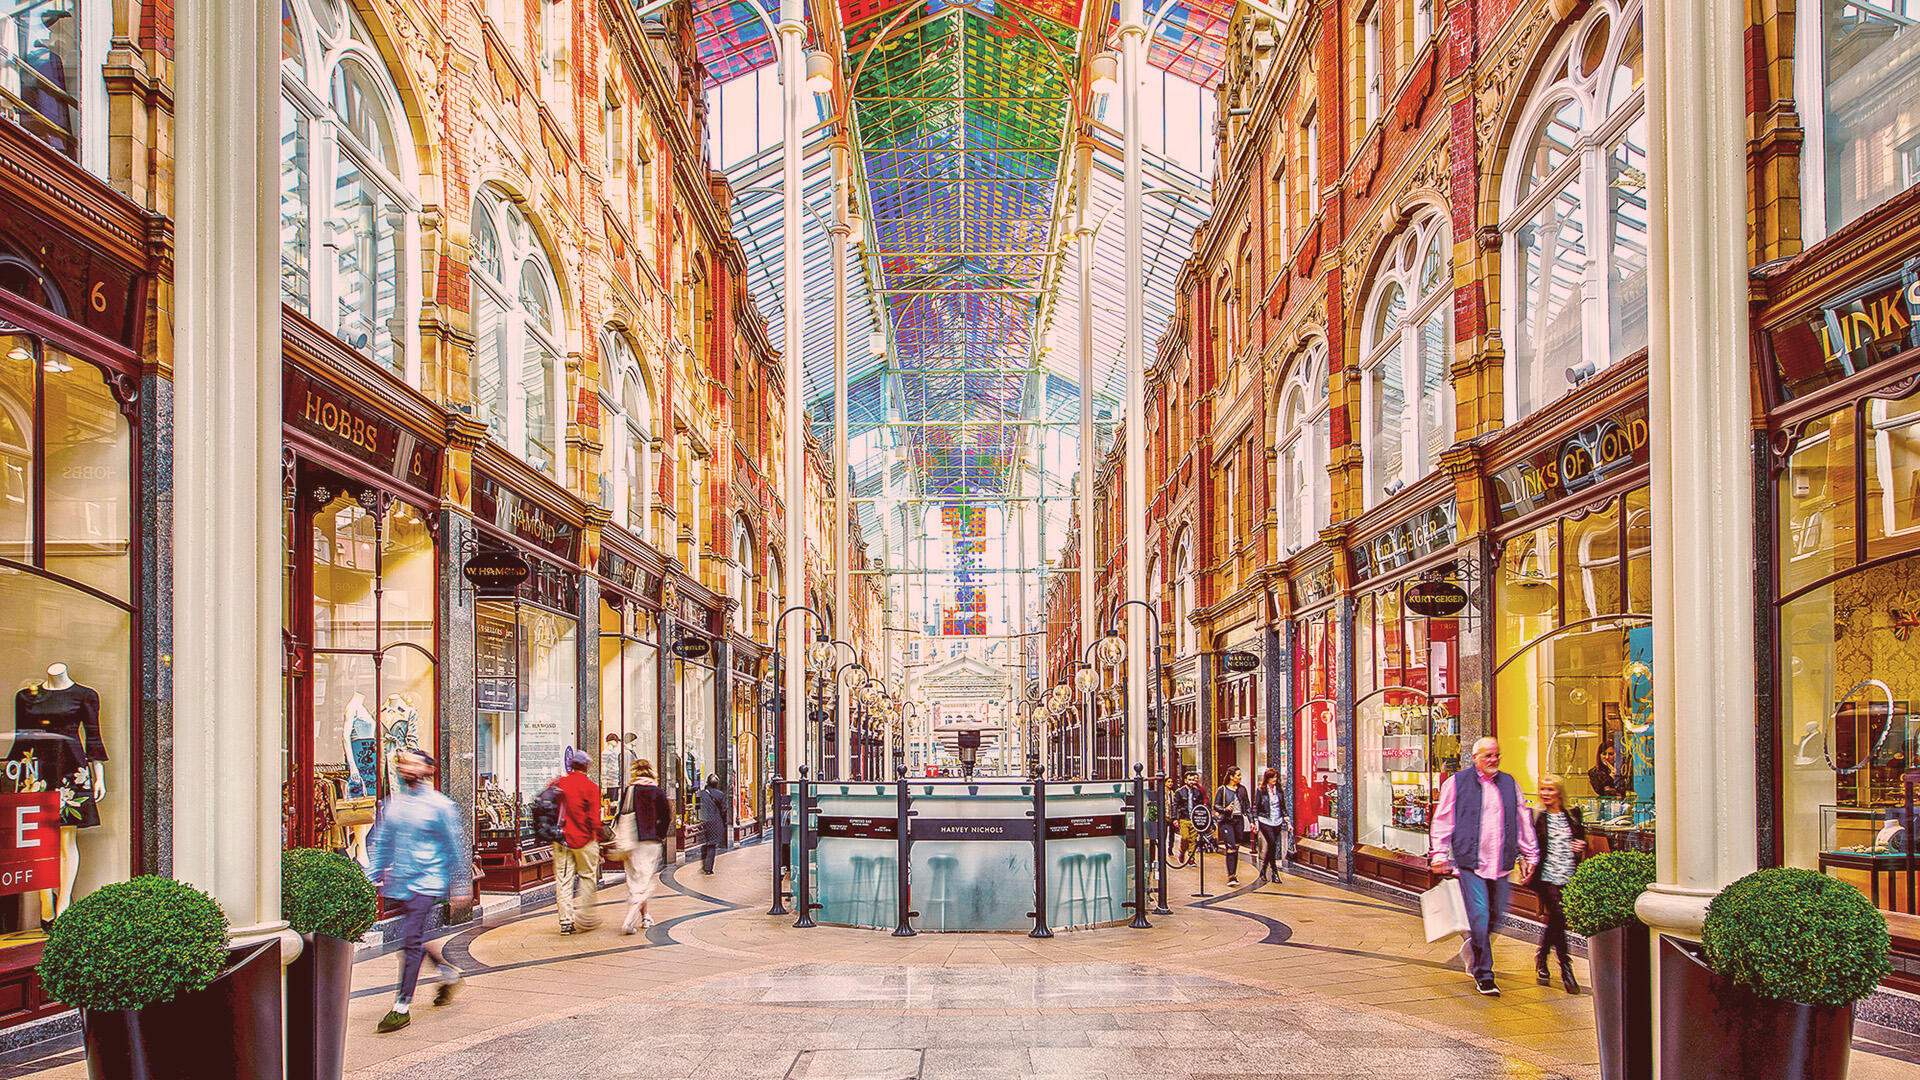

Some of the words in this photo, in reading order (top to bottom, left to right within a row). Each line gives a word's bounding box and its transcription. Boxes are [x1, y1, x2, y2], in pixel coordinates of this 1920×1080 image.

[90, 281, 107, 312] 6
[304, 390, 378, 453] HOBBS
[413, 451, 422, 476] 8
[1511, 460, 1559, 504] LINKS
[1563, 448, 1587, 480] OF
[509, 503, 556, 544] HAMOND
[1399, 520, 1439, 553] GEIGER
[479, 567, 527, 576] HAMOND
[1409, 595, 1431, 603] KURT
[1434, 595, 1464, 603] GEIGER
[2, 869, 33, 886] OFF
